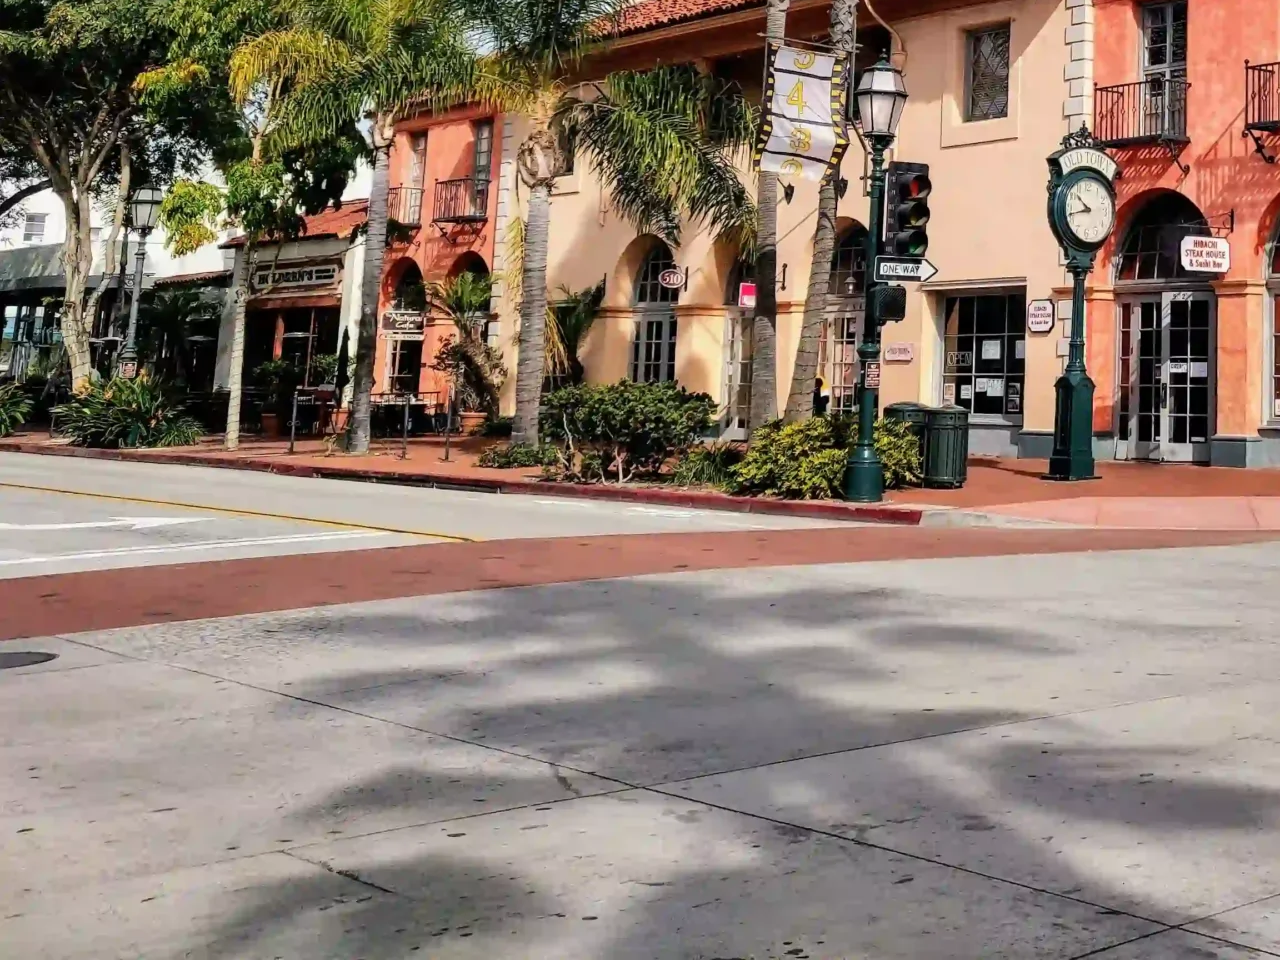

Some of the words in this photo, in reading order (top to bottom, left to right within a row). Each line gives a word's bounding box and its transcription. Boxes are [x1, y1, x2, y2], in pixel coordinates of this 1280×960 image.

[786, 79, 807, 115] 4
[1064, 151, 1082, 168] OLD
[1085, 152, 1112, 174] TOWN
[1185, 248, 1204, 258] STEAK
[1206, 250, 1226, 259] HOUSE
[883, 264, 900, 274] ONE
[902, 265, 920, 275] WAY
[663, 273, 680, 284] 510
[948, 352, 972, 366] OPEN
